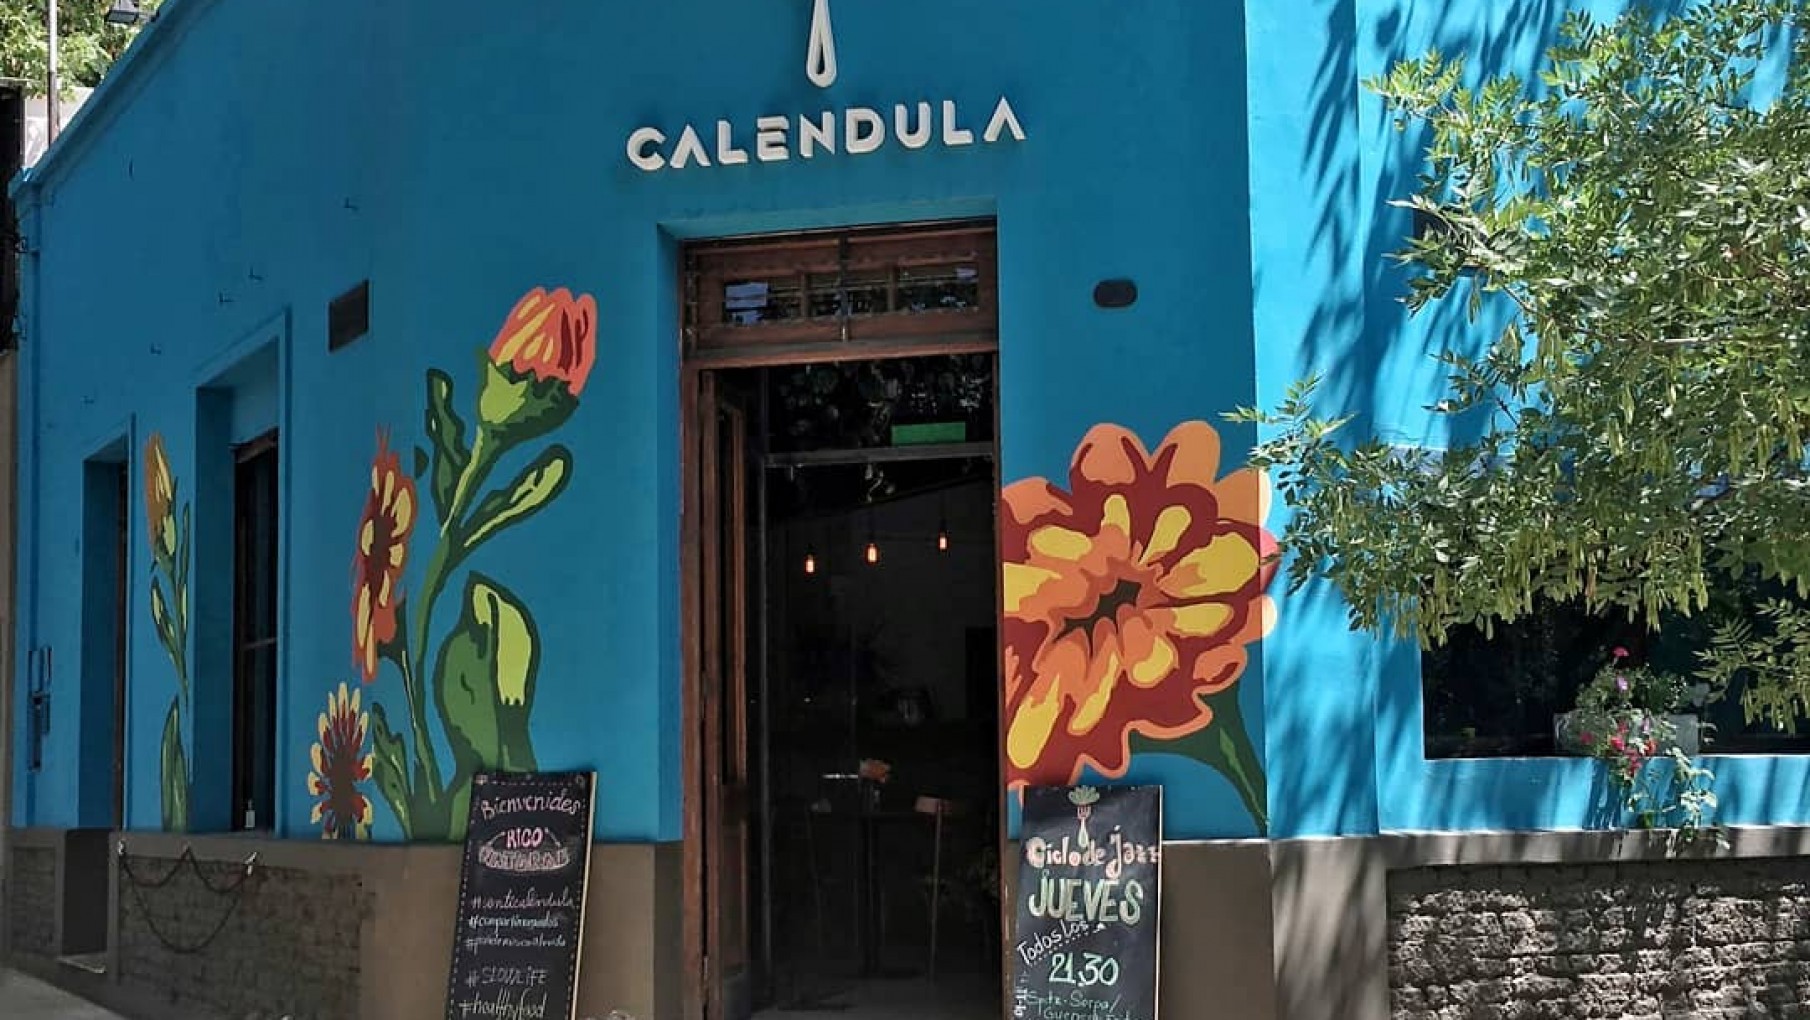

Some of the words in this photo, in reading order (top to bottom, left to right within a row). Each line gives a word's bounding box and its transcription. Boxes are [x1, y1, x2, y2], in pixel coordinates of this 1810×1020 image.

[626, 97, 1026, 171] CALENDULA
[507, 827, 544, 850] RICO
[1026, 836, 1082, 868] Ciclo
[1082, 838, 1106, 866] de
[1028, 874, 1144, 925] JUEVES
[1017, 926, 1062, 966] Todos
